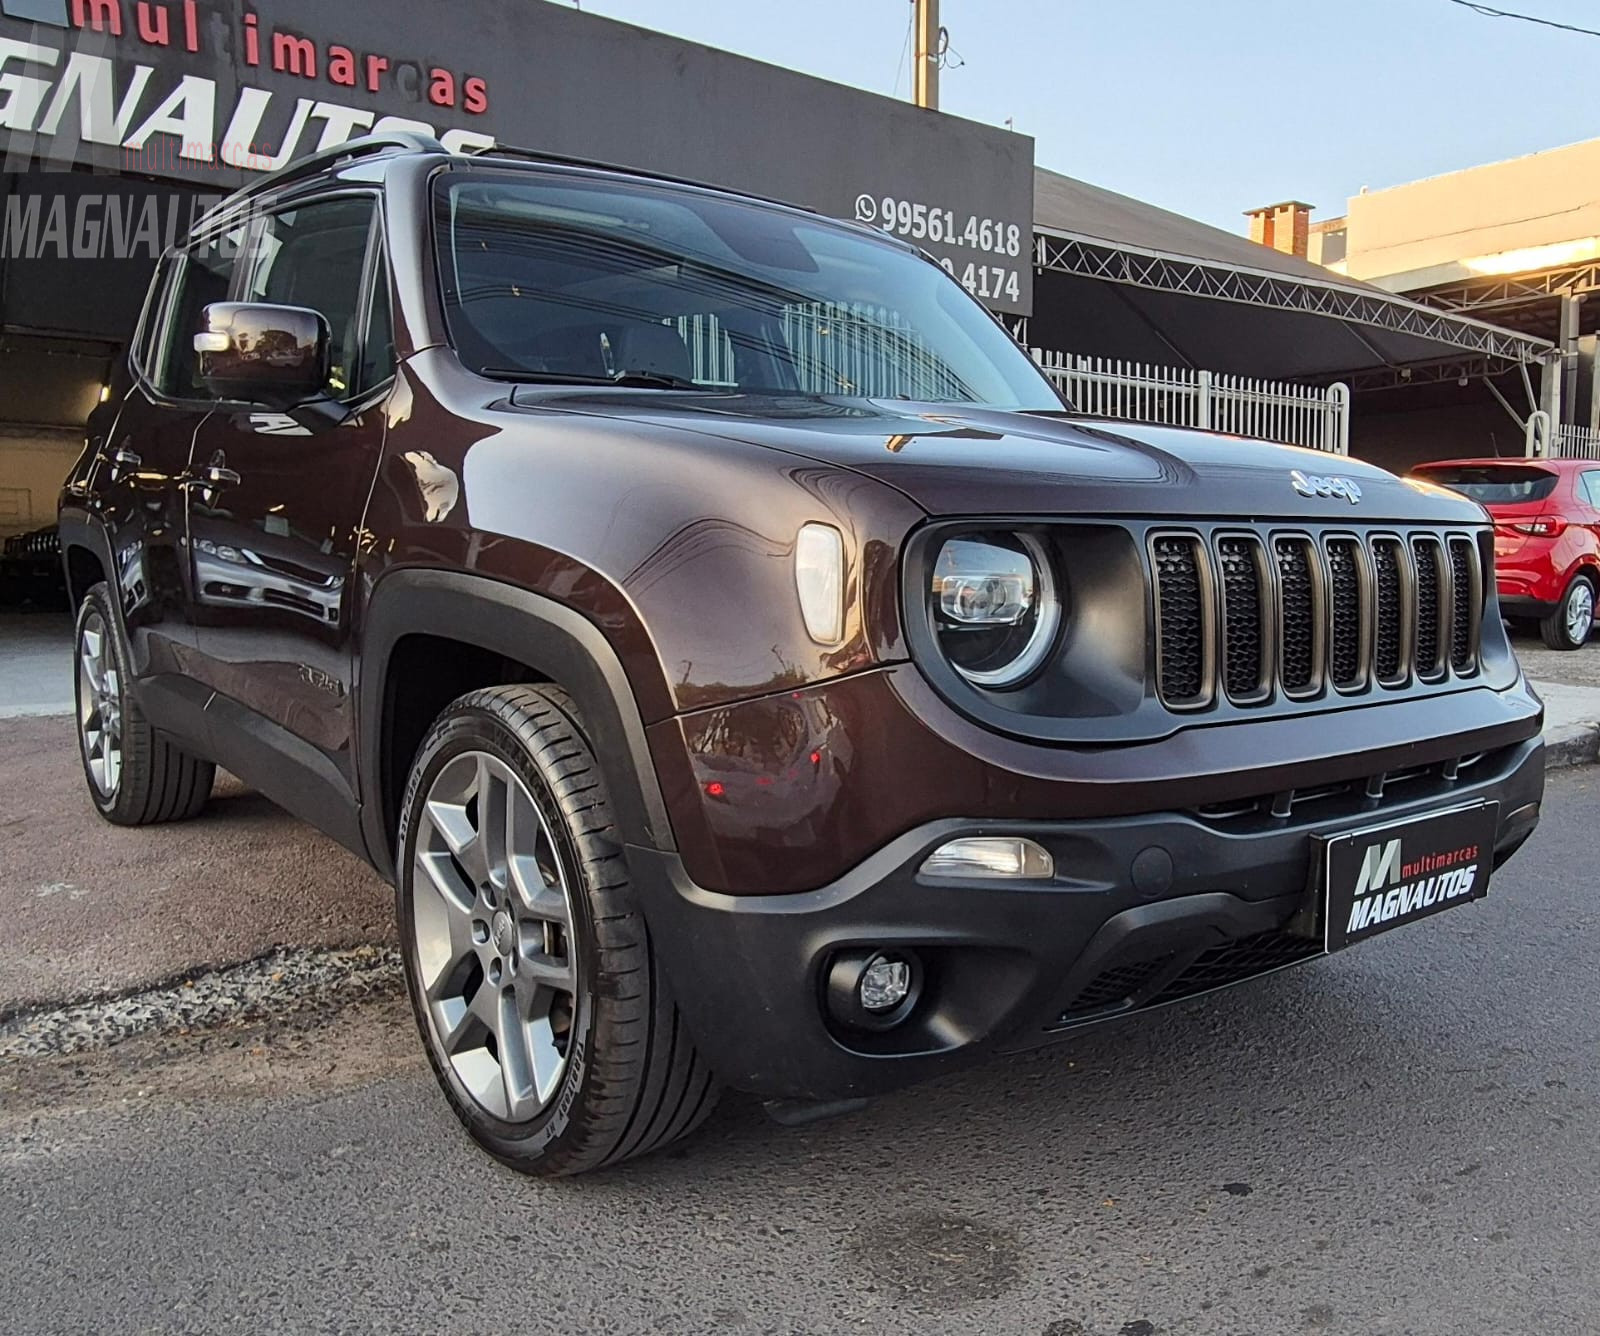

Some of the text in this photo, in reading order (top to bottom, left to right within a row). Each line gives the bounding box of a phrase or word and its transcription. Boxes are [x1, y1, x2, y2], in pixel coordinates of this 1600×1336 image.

[881, 197, 1020, 257] 99561.4618
[1290, 470, 1362, 505] Jeep
[1402, 844, 1479, 879] multimarcas
[1346, 864, 1478, 934] MAGNAUTOS
